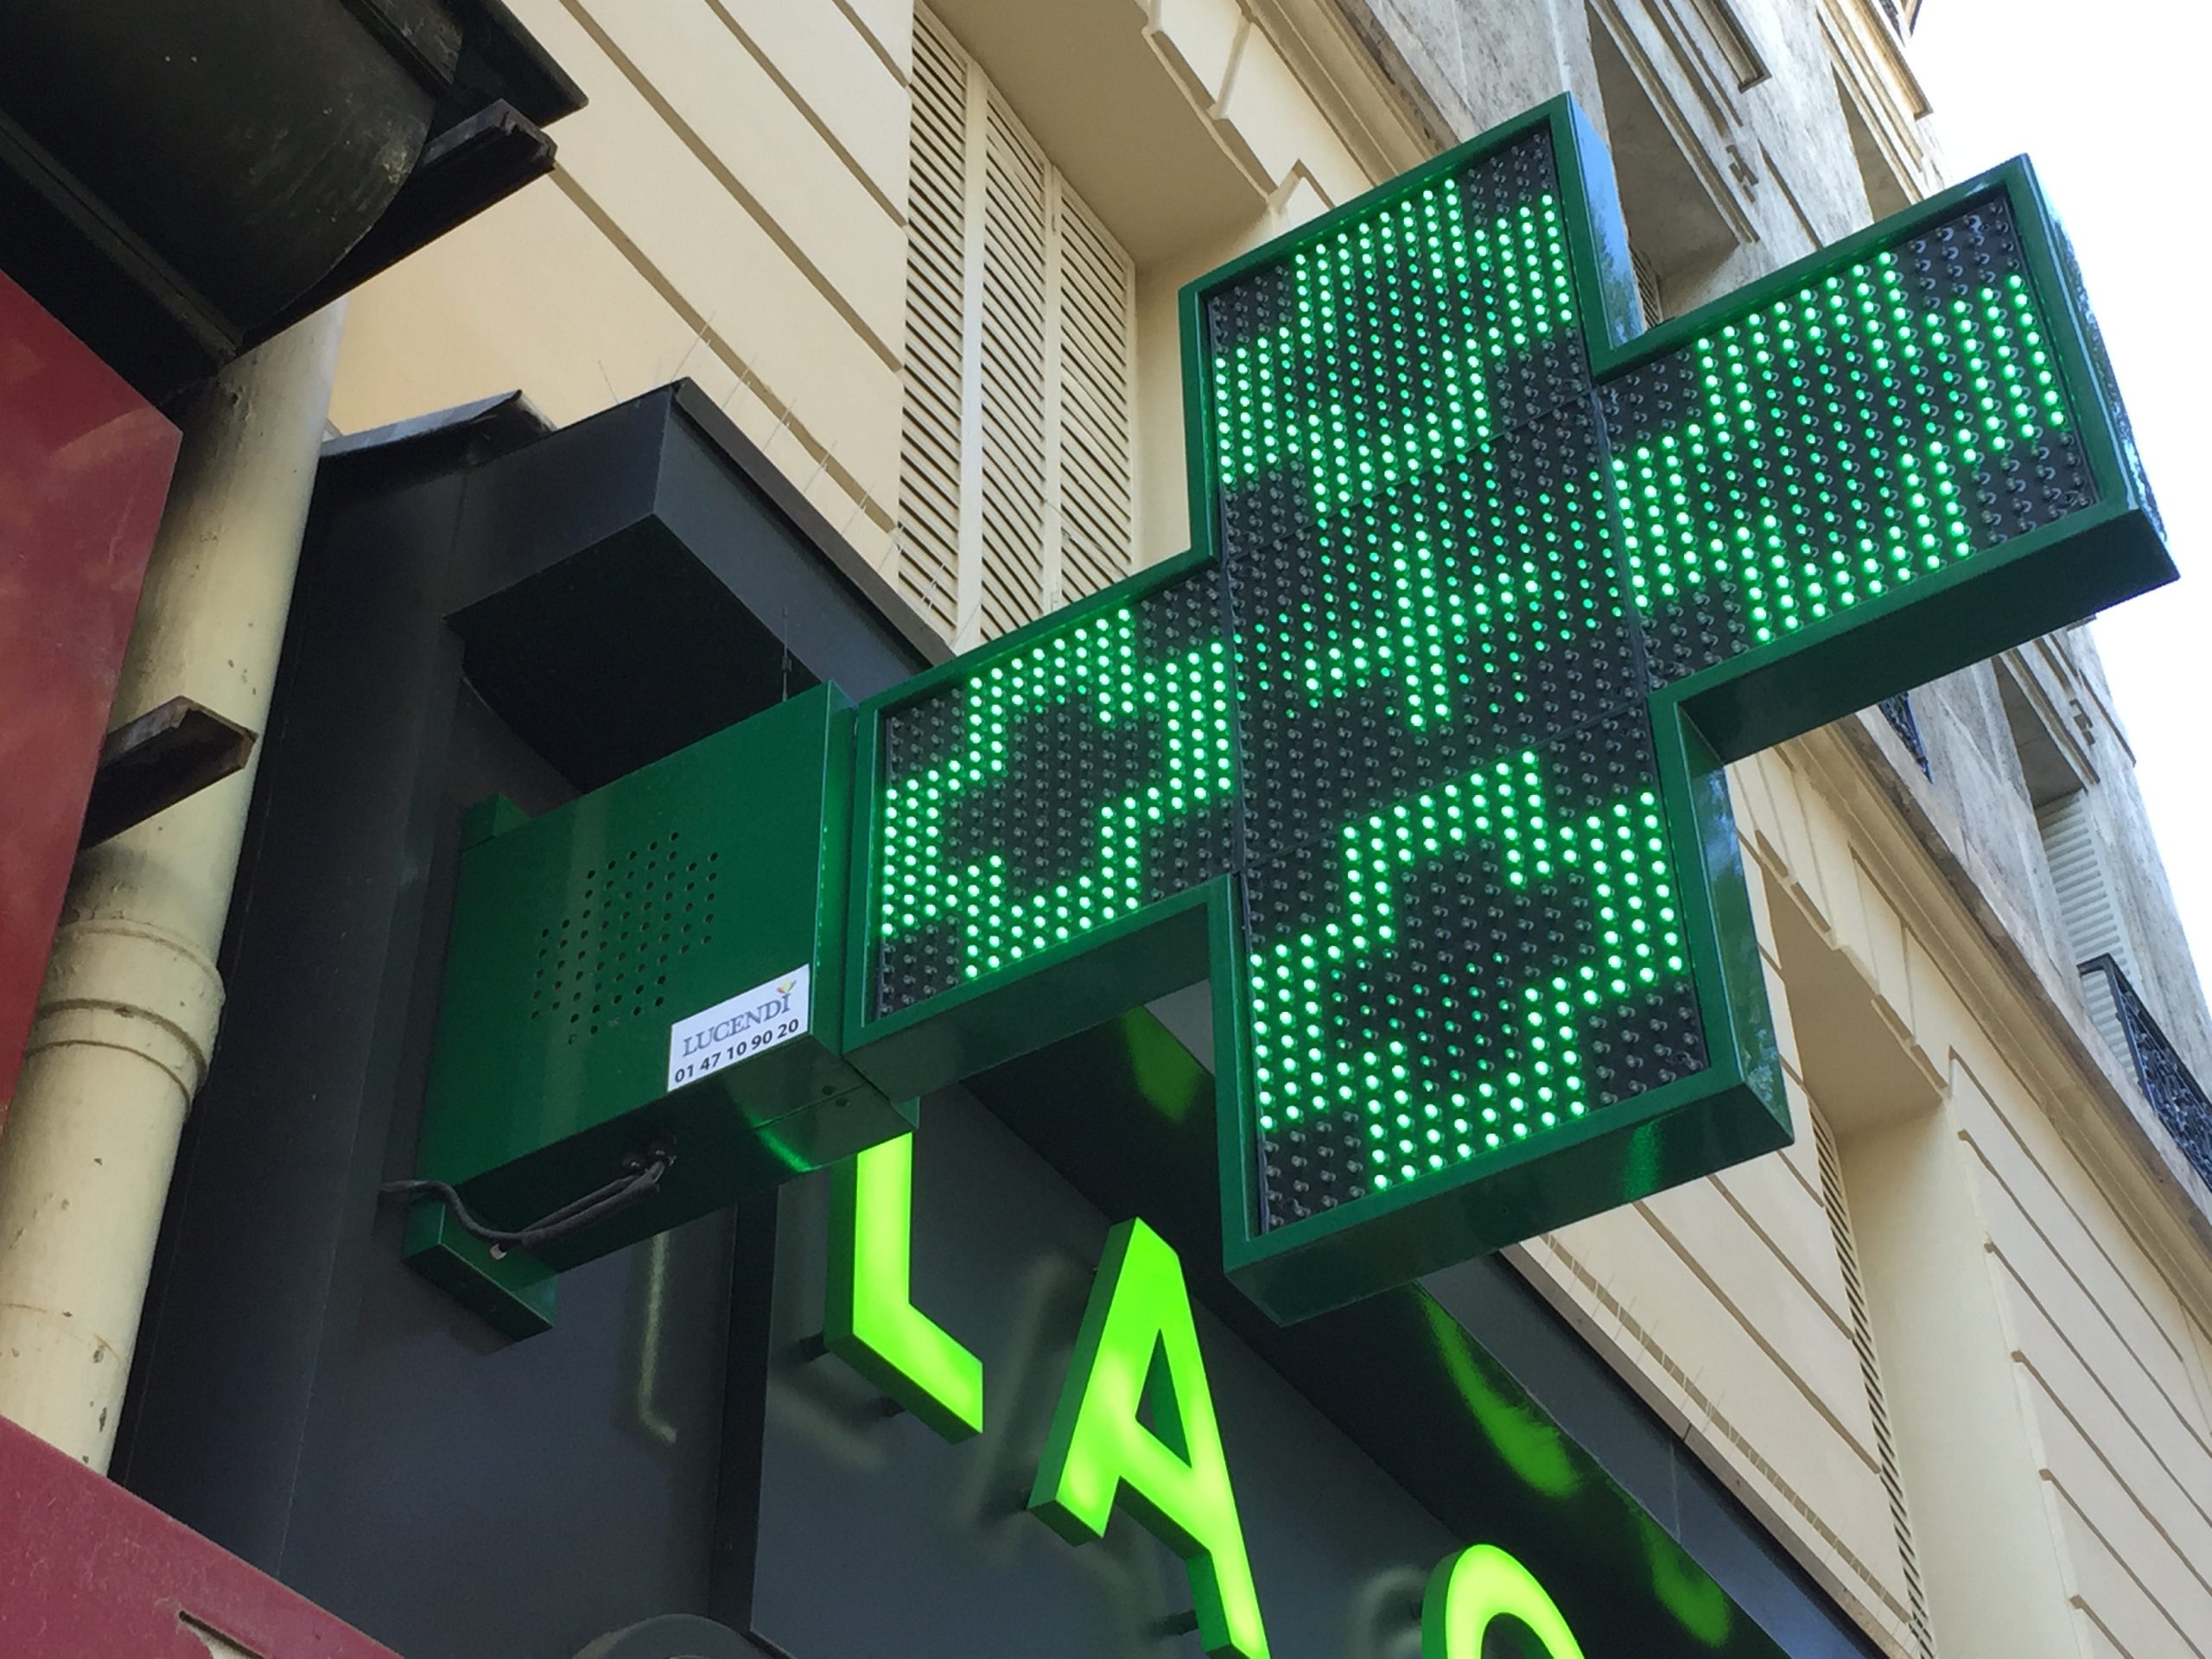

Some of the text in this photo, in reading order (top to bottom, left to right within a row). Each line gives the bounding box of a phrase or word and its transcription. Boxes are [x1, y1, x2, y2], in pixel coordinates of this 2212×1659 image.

[674, 1018, 799, 1083] 01 47 10 90 20
[682, 993, 791, 1058] LUCENDI
